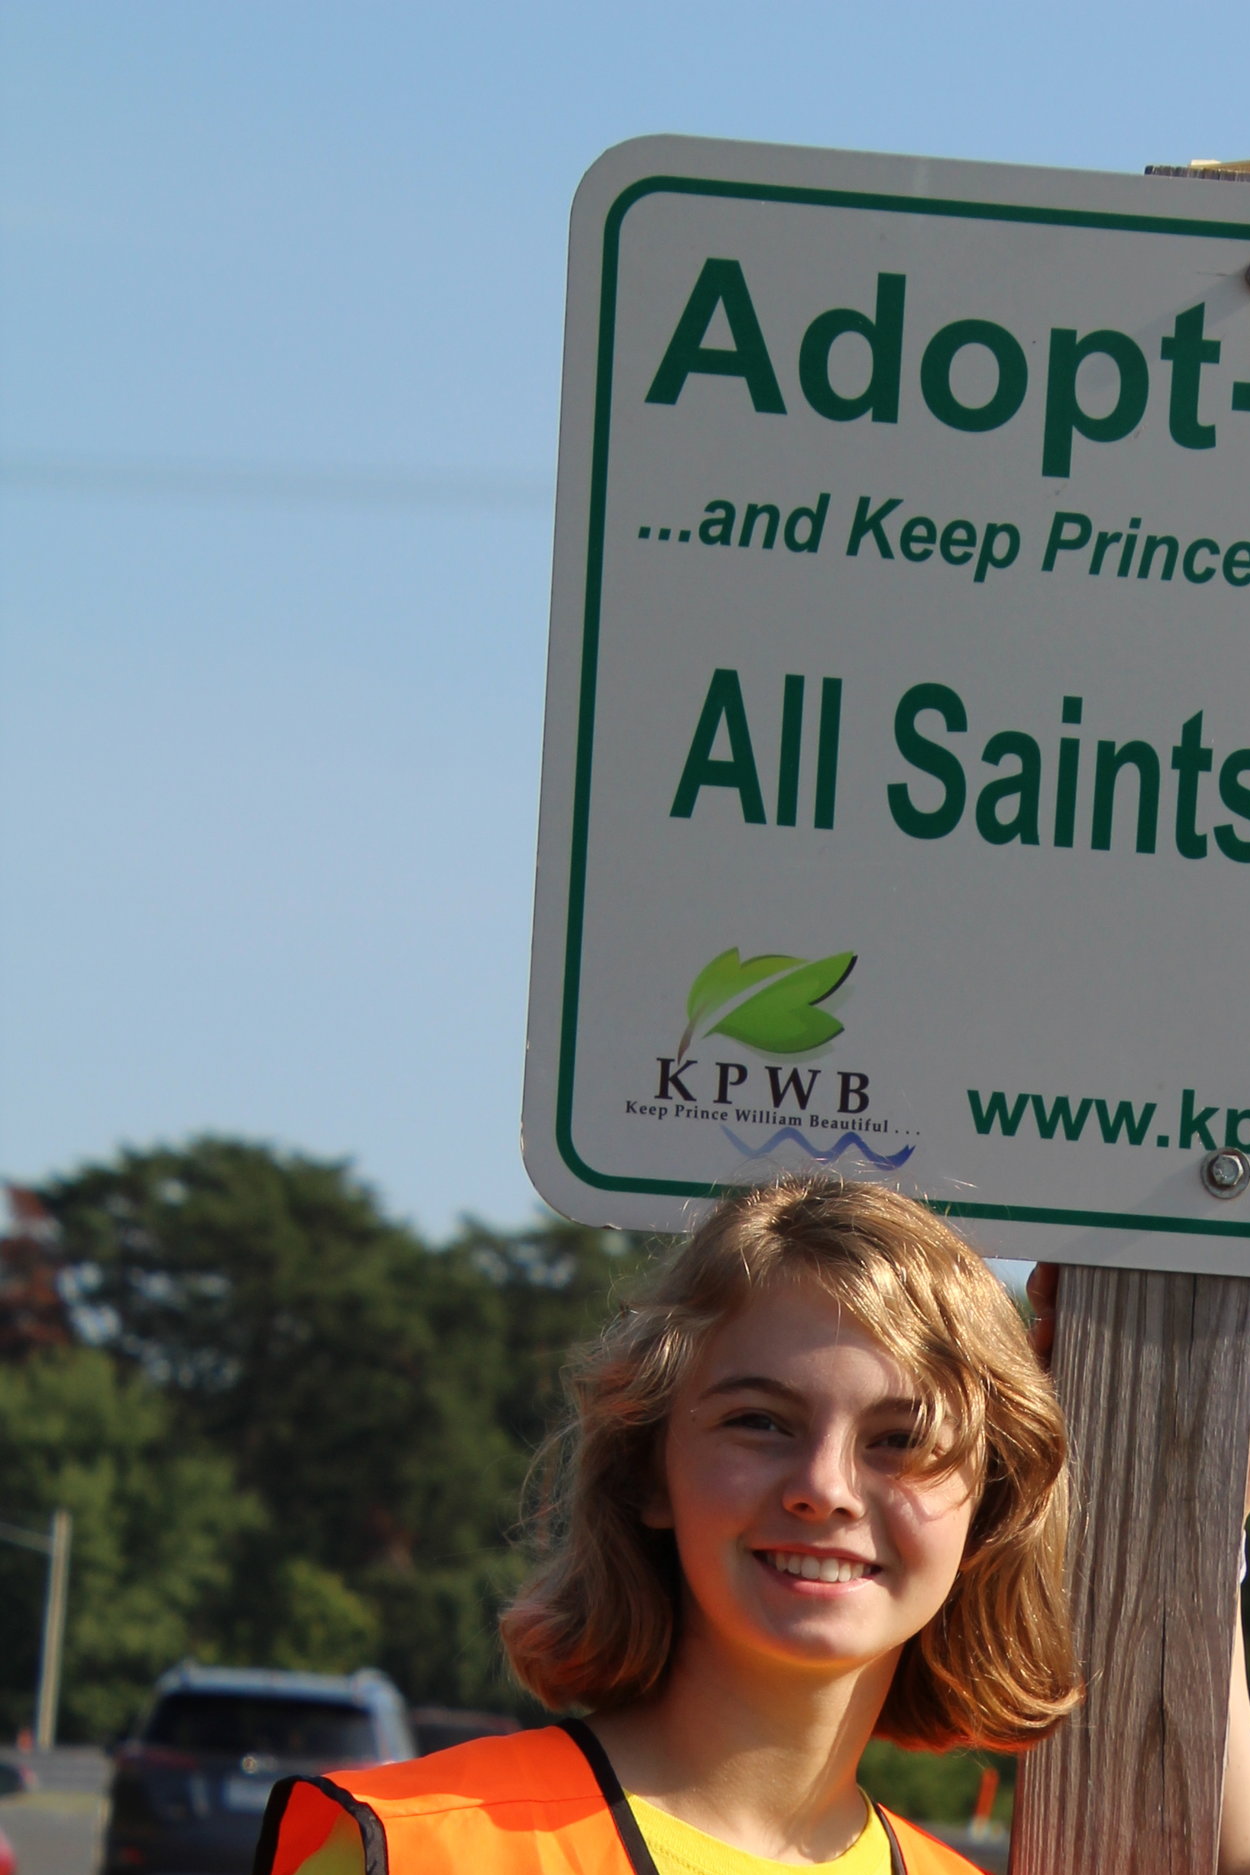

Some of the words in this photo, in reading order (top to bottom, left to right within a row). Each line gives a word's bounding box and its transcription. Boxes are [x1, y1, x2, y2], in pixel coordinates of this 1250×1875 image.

[637, 493, 832, 553] ...and
[845, 495, 1021, 584] Keep
[668, 667, 843, 831] All
[625, 1100, 668, 1120] Keep
[675, 1104, 728, 1121] Prince
[736, 1109, 802, 1126] William
